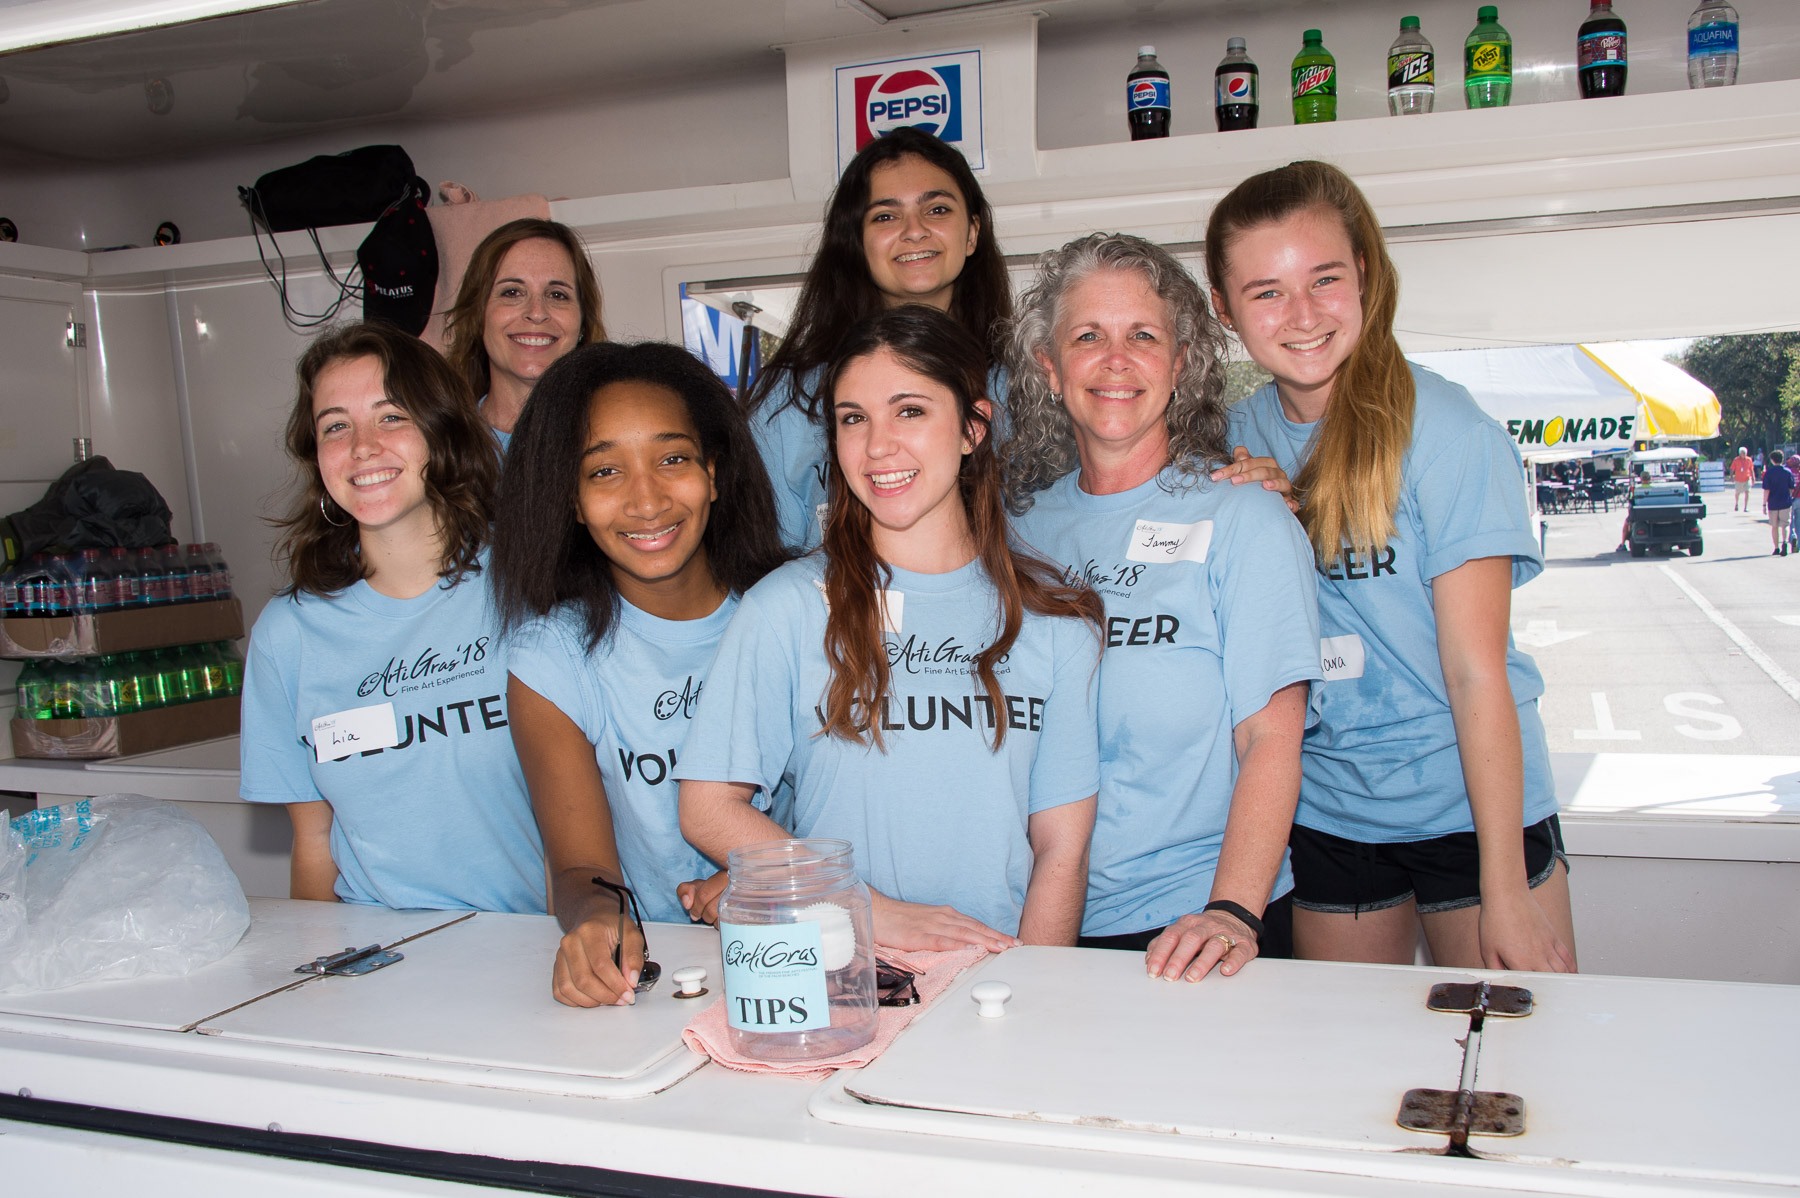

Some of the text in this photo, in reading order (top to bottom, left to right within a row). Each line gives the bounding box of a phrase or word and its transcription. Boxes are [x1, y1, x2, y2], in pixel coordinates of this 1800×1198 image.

[1693, 29, 1733, 43] AQUAFINA
[1402, 54, 1429, 84] ICE
[869, 93, 947, 122] PEPSI
[1133, 91, 1156, 99] PEPSI
[374, 283, 414, 297] PILATUS
[1107, 614, 1180, 649] EER
[401, 666, 486, 694] Fine Art Experienced
[924, 666, 943, 676] Fine
[944, 667, 958, 676] Art
[735, 996, 808, 1025] TIPS
